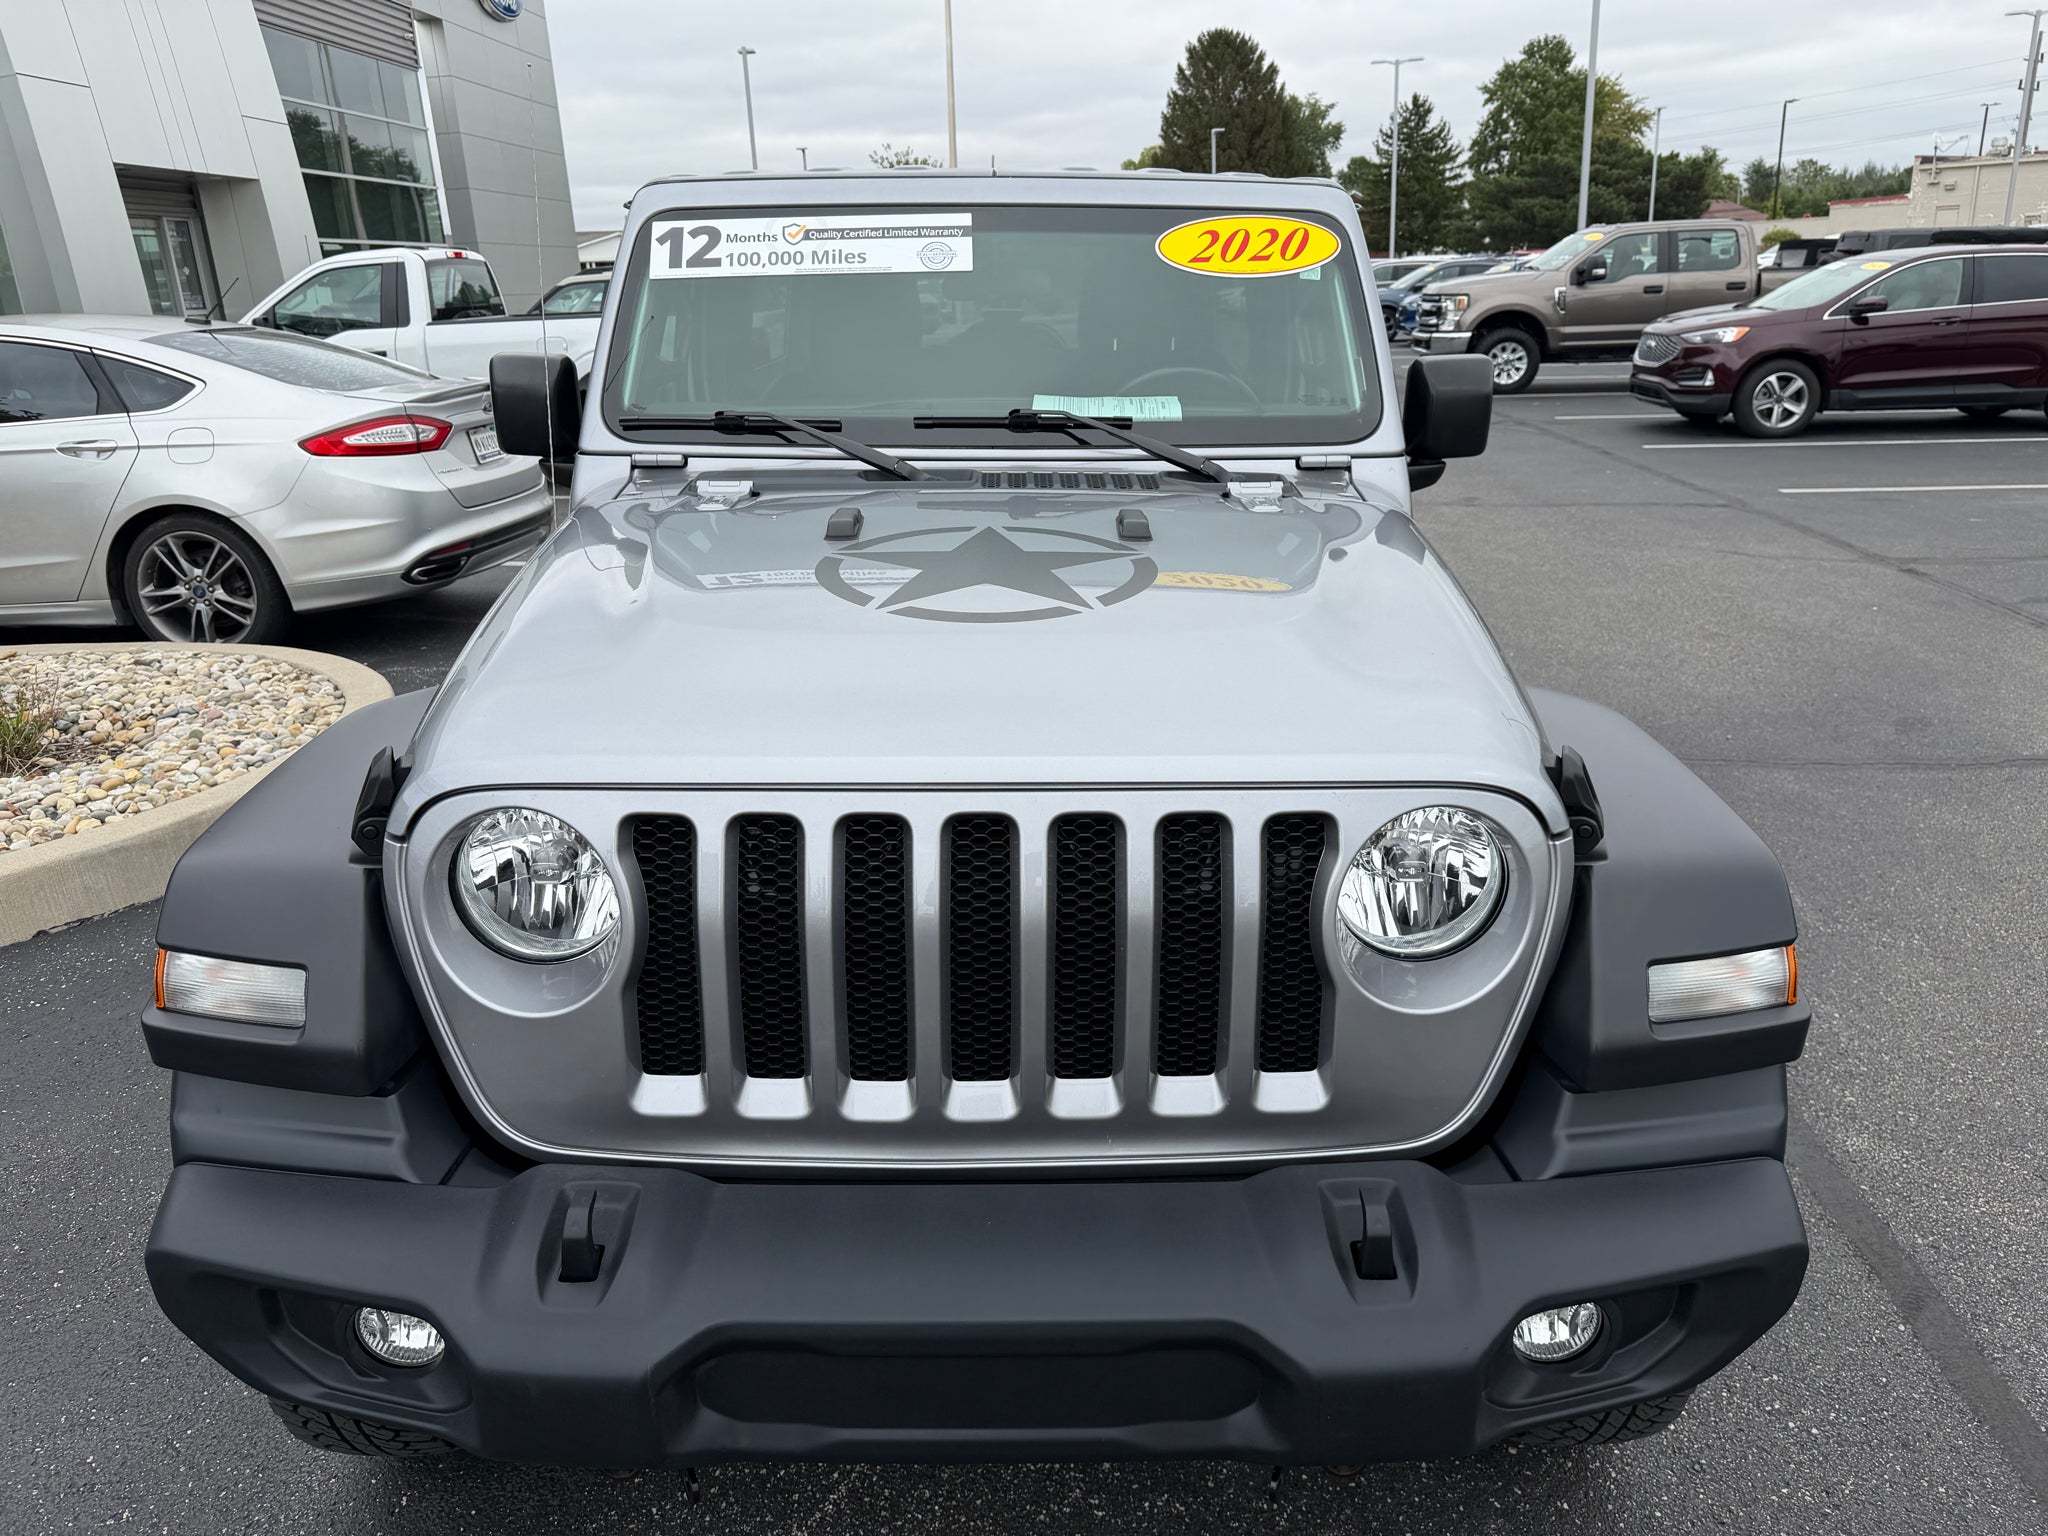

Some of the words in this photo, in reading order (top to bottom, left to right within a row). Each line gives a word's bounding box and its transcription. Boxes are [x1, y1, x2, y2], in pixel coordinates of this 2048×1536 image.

[726, 232, 778, 243] Months
[809, 230, 841, 240] Quality
[843, 229, 882, 238] Certified
[884, 228, 918, 237] Limited
[920, 227, 964, 238] Warranty
[655, 225, 722, 269] 12
[1187, 227, 1310, 263] 2020
[725, 250, 805, 268] 100,000
[811, 249, 867, 265] Miles
